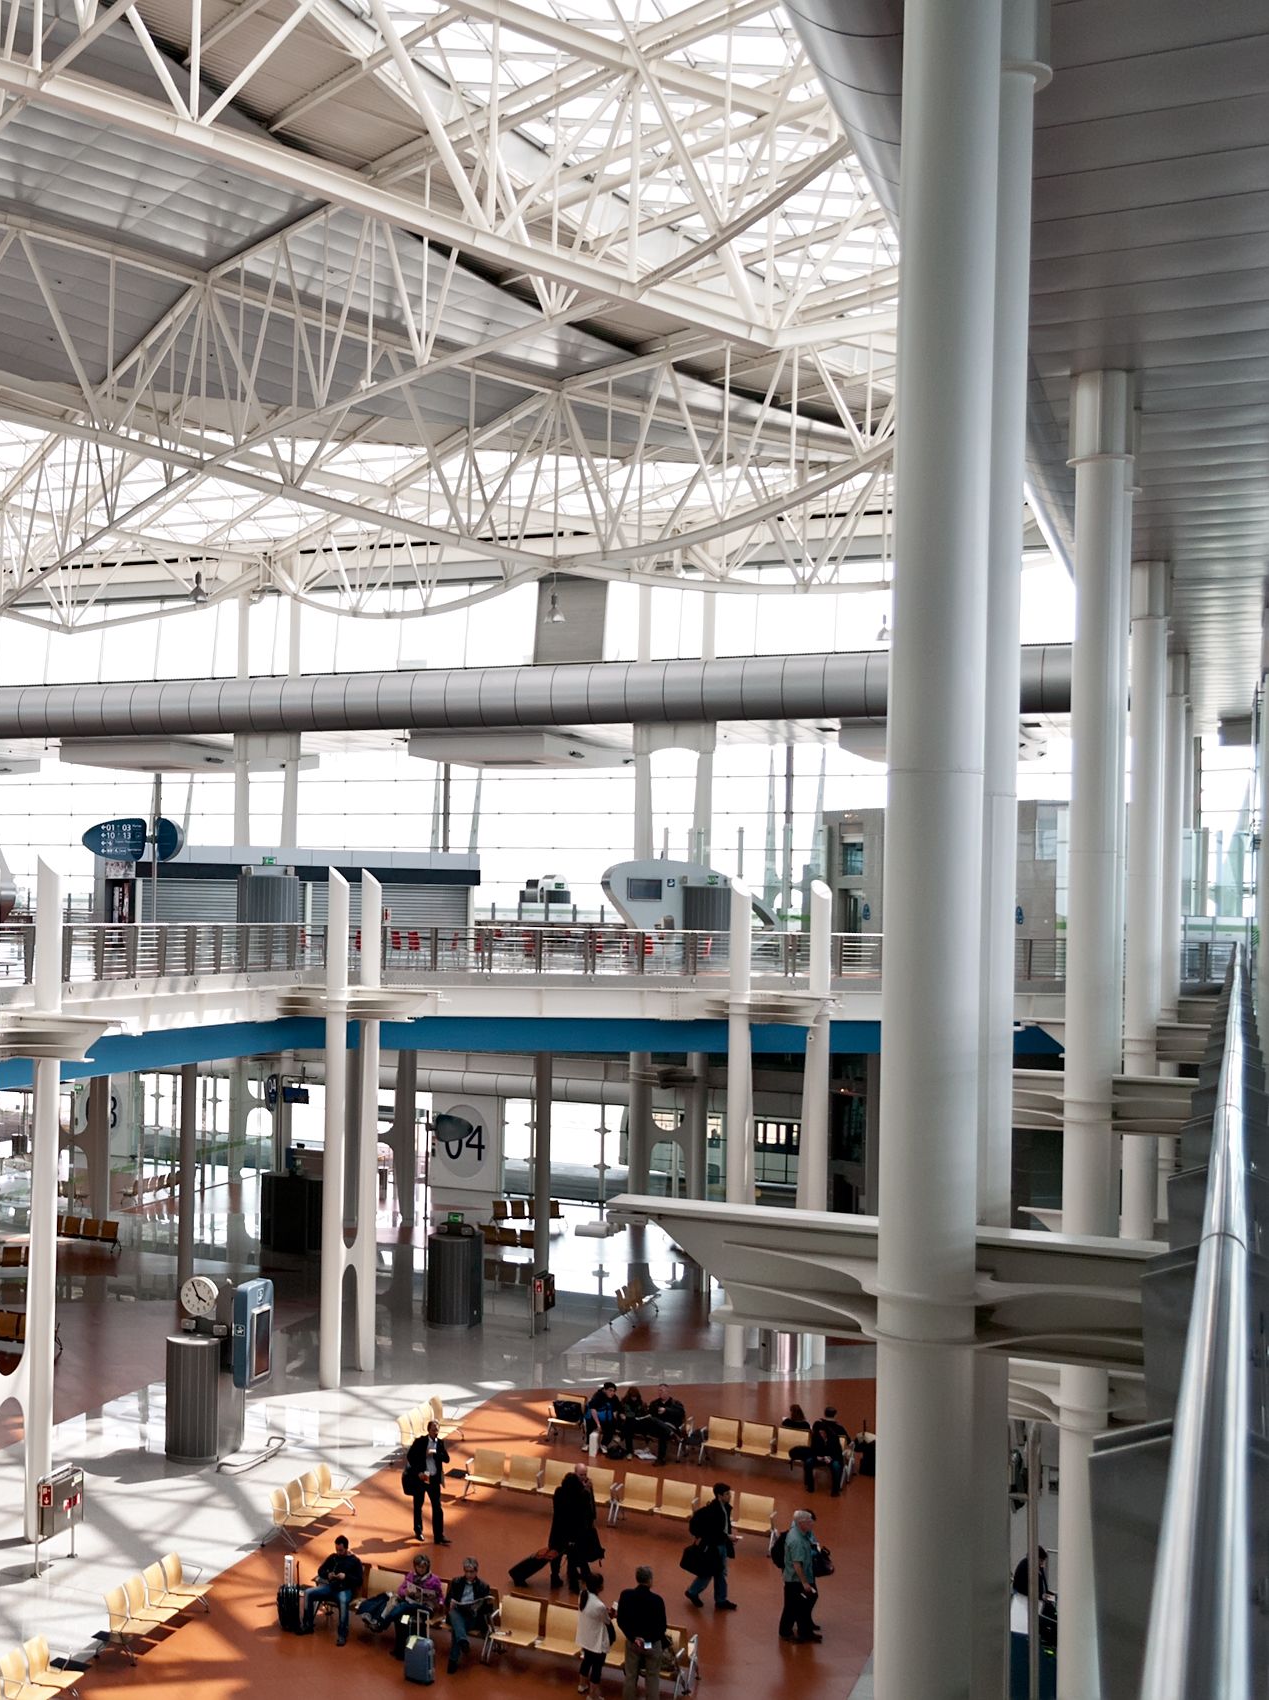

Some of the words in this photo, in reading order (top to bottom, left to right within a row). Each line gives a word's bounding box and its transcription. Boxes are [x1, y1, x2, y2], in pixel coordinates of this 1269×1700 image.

[106, 823, 115, 831] 01
[122, 823, 132, 831] 03
[106, 831, 116, 839] 10
[122, 832, 132, 840] 13
